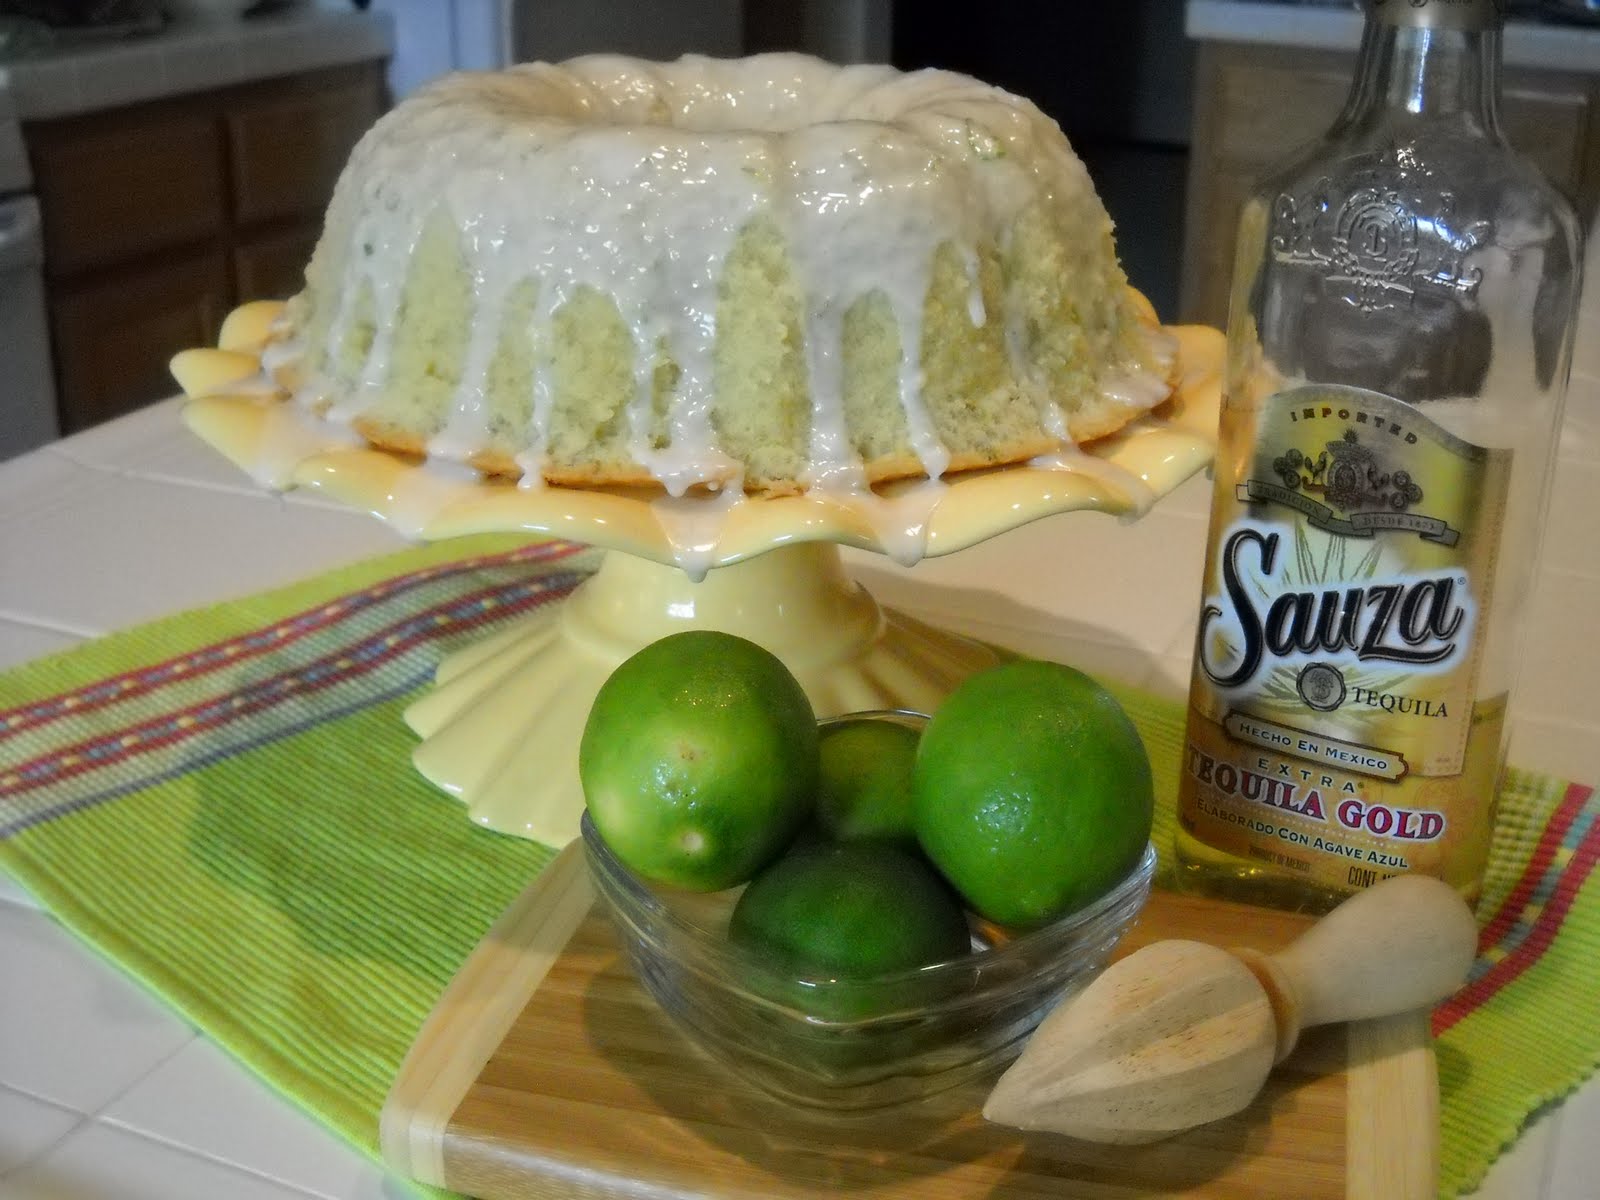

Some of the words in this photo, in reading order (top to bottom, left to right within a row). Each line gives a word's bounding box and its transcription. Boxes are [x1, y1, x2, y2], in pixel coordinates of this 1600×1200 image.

[1290, 407, 1418, 445] IMPORTED
[1200, 528, 1464, 688] Sauza
[1352, 686, 1448, 718] TEQUILA
[1239, 722, 1292, 746] HECHO
[1297, 739, 1319, 753] EN
[1325, 746, 1388, 770] MEXICO
[1188, 743, 1326, 820] TEQUILA
[1338, 800, 1445, 839] GOLD
[1257, 757, 1356, 793] EXTRA
[1197, 798, 1274, 835] ELABORADO
[1278, 827, 1310, 845] CON
[1313, 837, 1363, 860] AGAVE
[1367, 850, 1408, 868] AZUL
[1347, 865, 1378, 888] CONT
